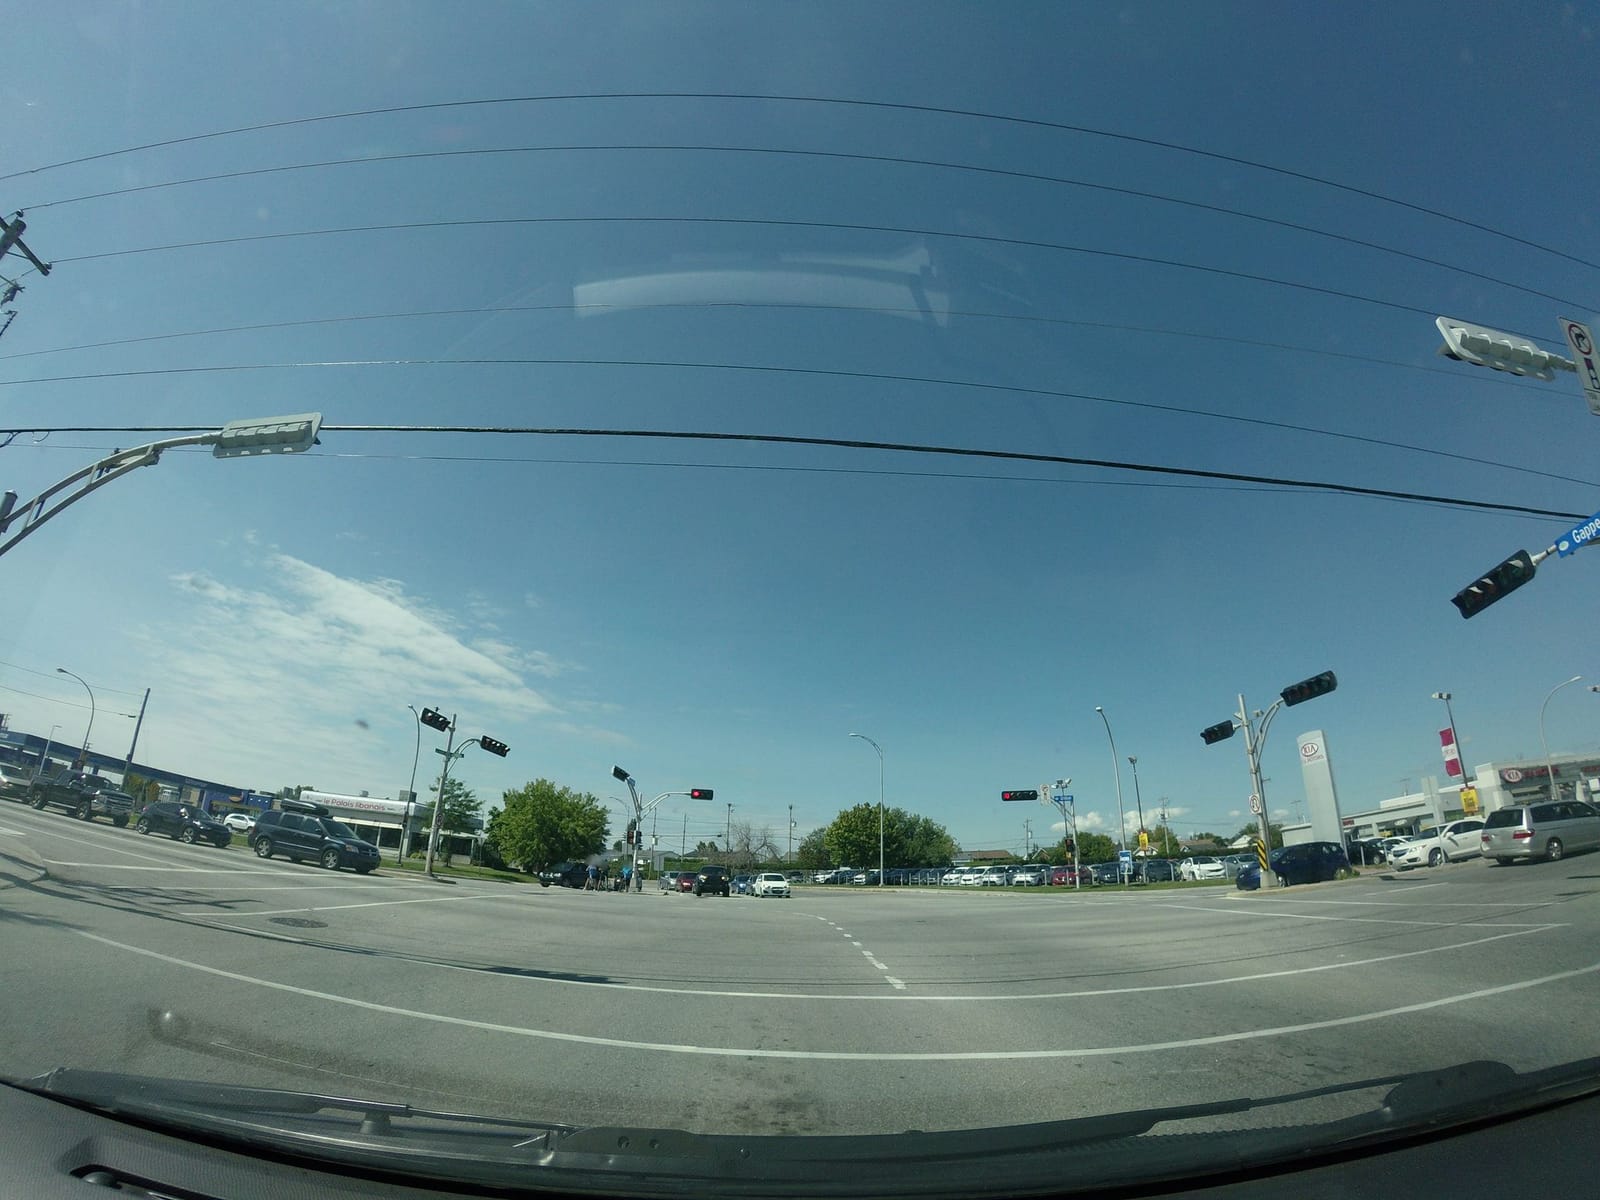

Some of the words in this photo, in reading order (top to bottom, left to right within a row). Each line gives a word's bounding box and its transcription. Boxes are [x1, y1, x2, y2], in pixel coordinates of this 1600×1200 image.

[1572, 518, 1600, 544] Gappe
[1303, 744, 1317, 755] KIA
[331, 799, 354, 808] Palais
